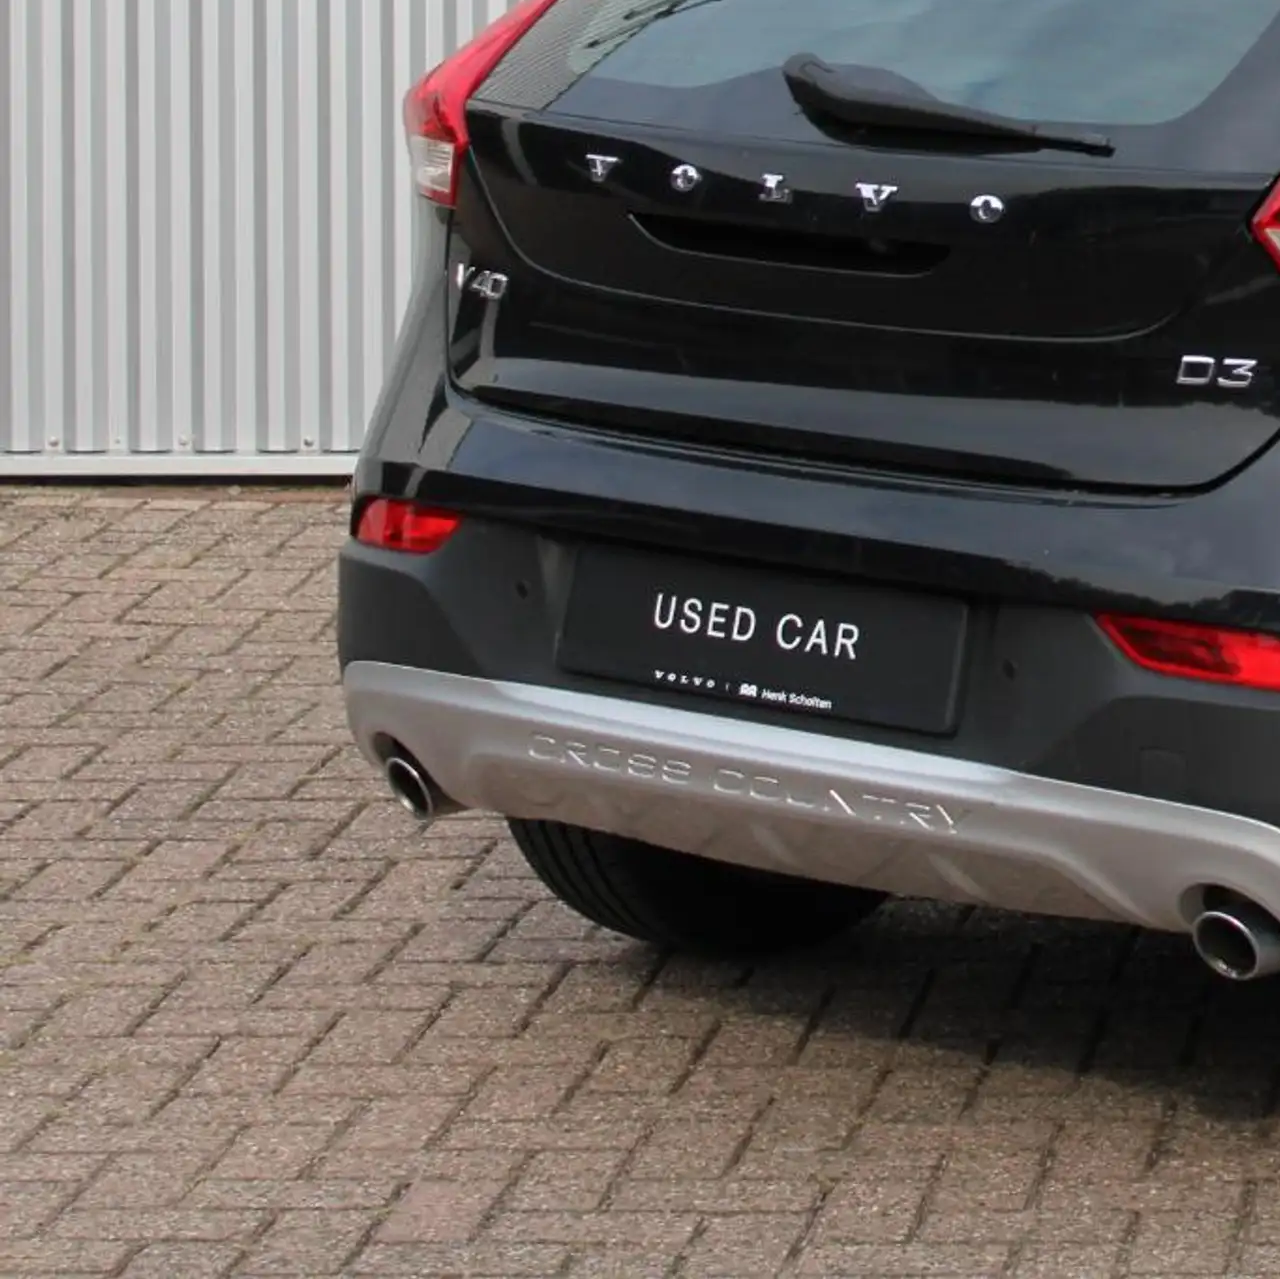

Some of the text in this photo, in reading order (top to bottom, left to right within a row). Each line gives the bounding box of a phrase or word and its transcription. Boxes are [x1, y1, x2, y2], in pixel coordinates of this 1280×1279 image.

[585, 153, 1005, 223] VOLVO
[455, 262, 510, 300] V40
[1175, 354, 1258, 388] D3
[653, 592, 861, 660] USED CAR
[654, 669, 833, 711] VOLVO Henk Scholten
